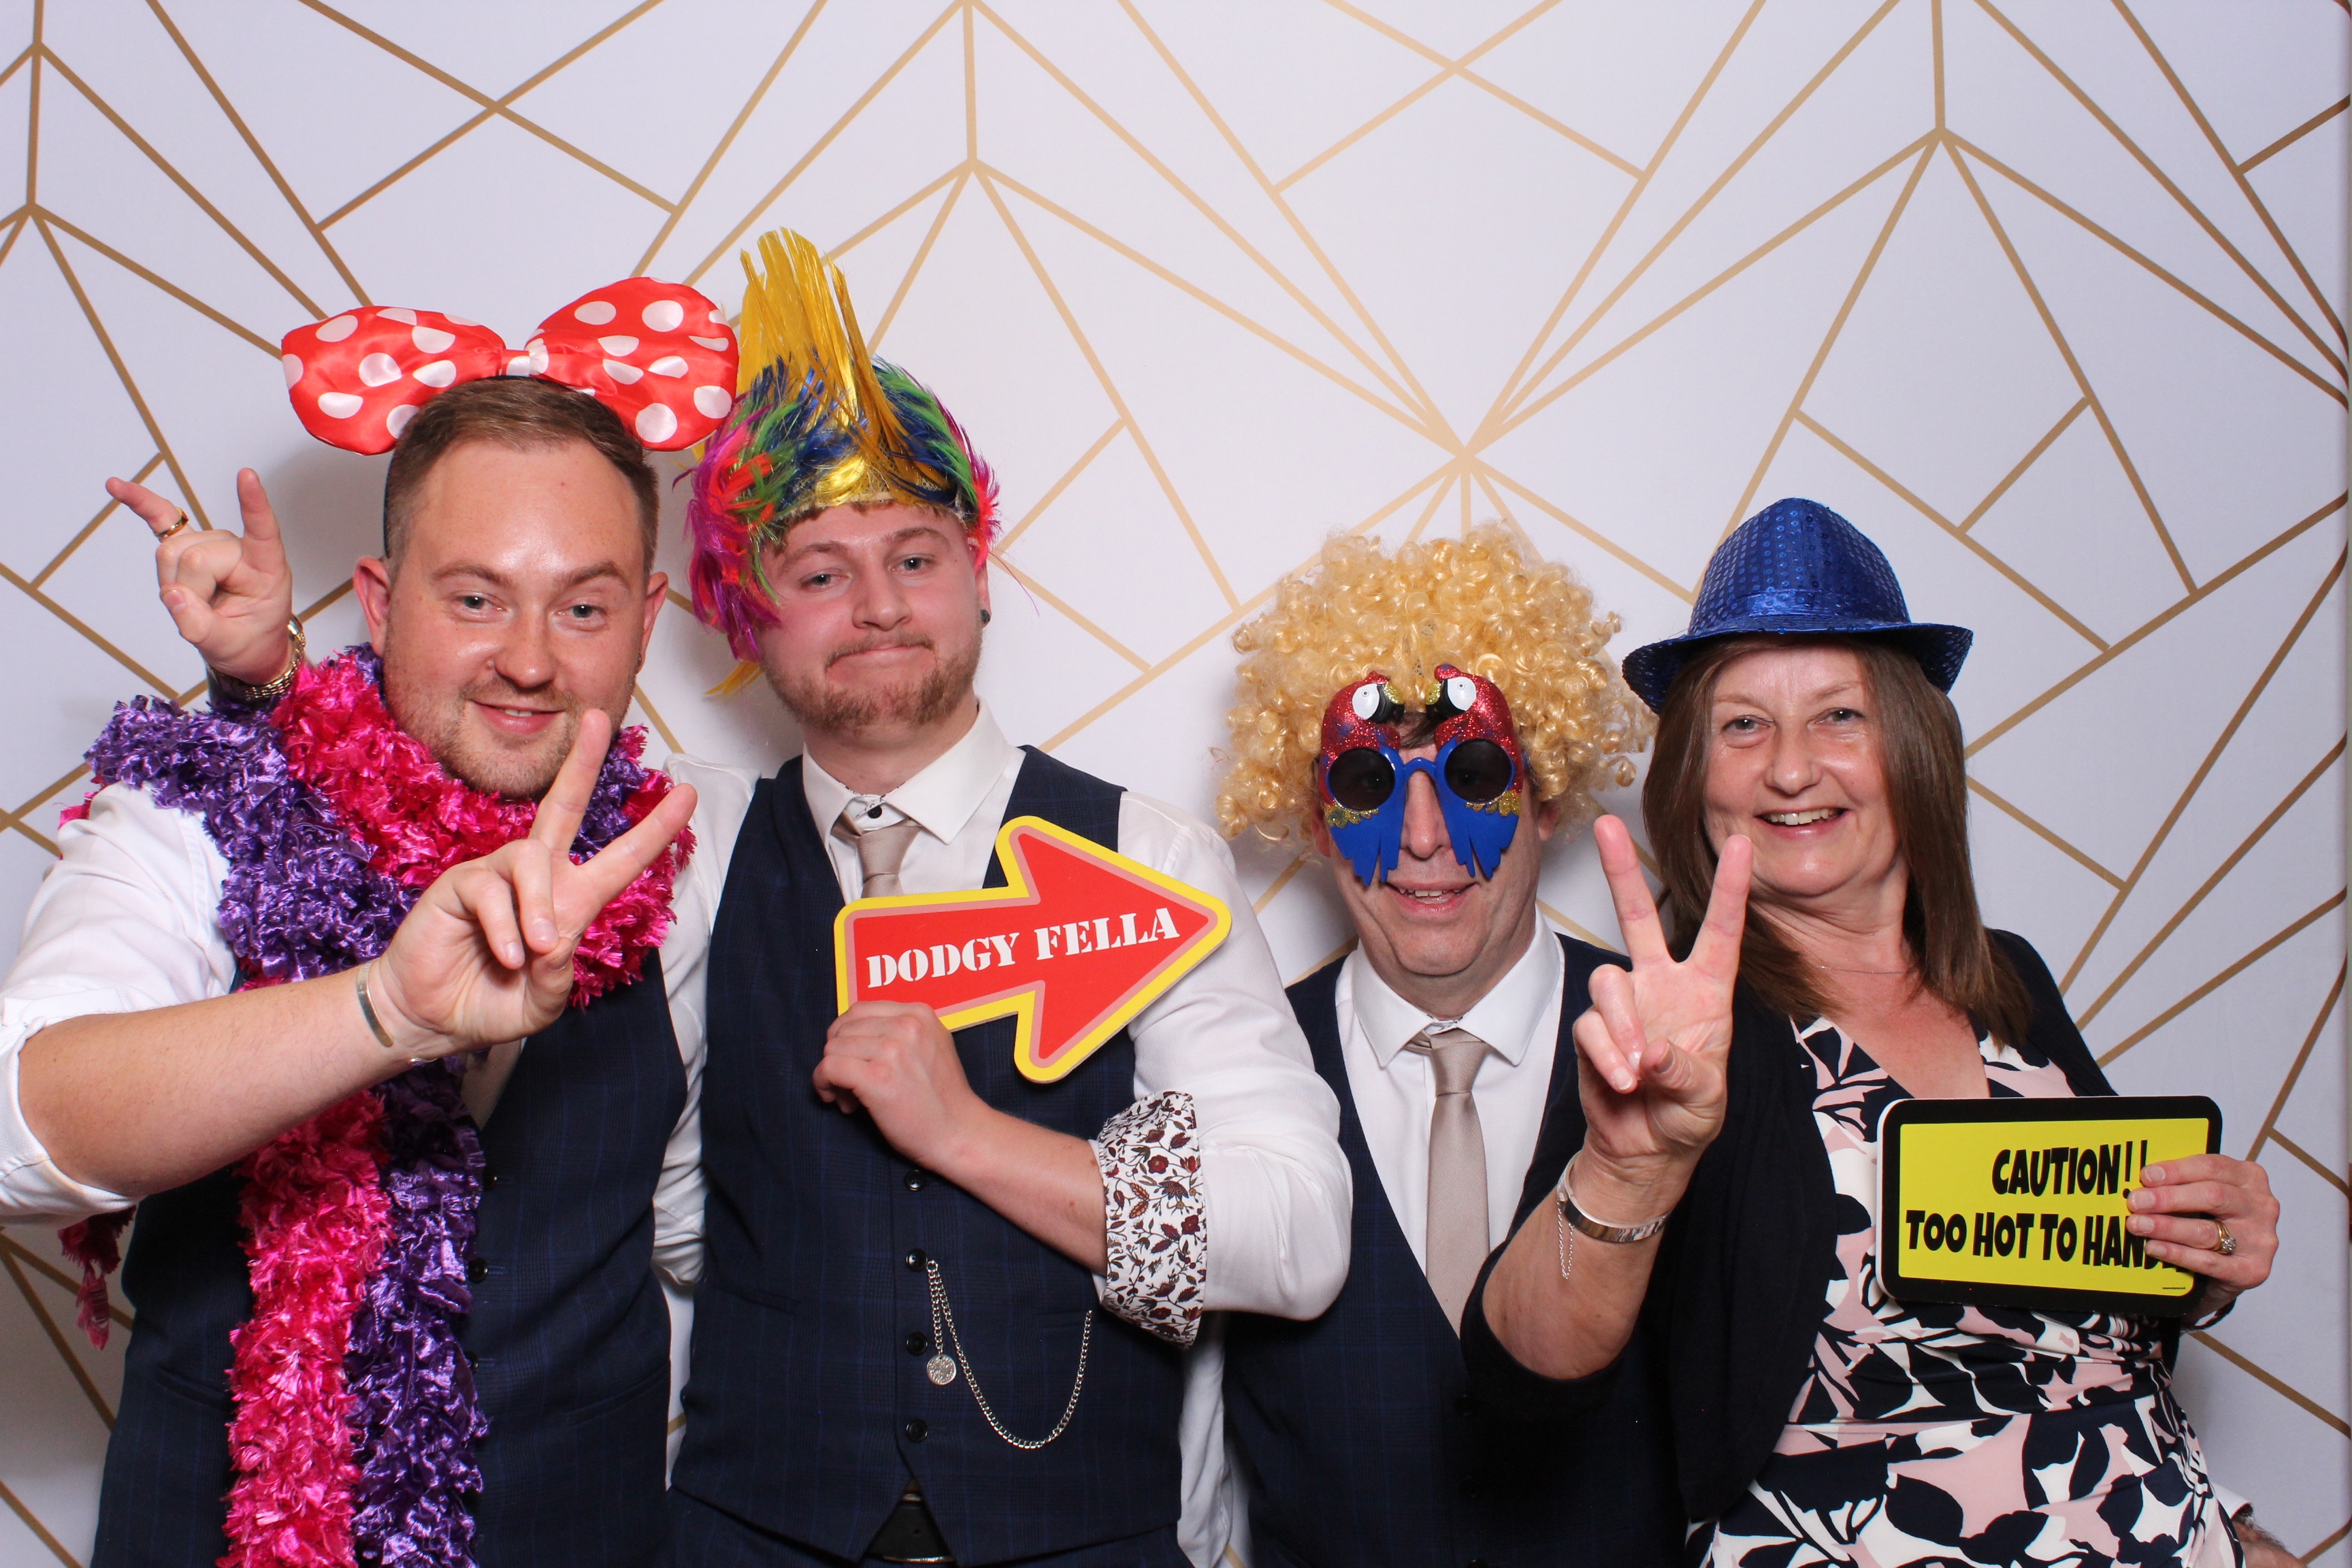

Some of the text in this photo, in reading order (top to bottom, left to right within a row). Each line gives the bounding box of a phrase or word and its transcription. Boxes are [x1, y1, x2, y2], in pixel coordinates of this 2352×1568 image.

[866, 907, 1180, 988] DODGY FELLA
[1906, 1210, 2190, 1273] TOO HOT TO HAN
